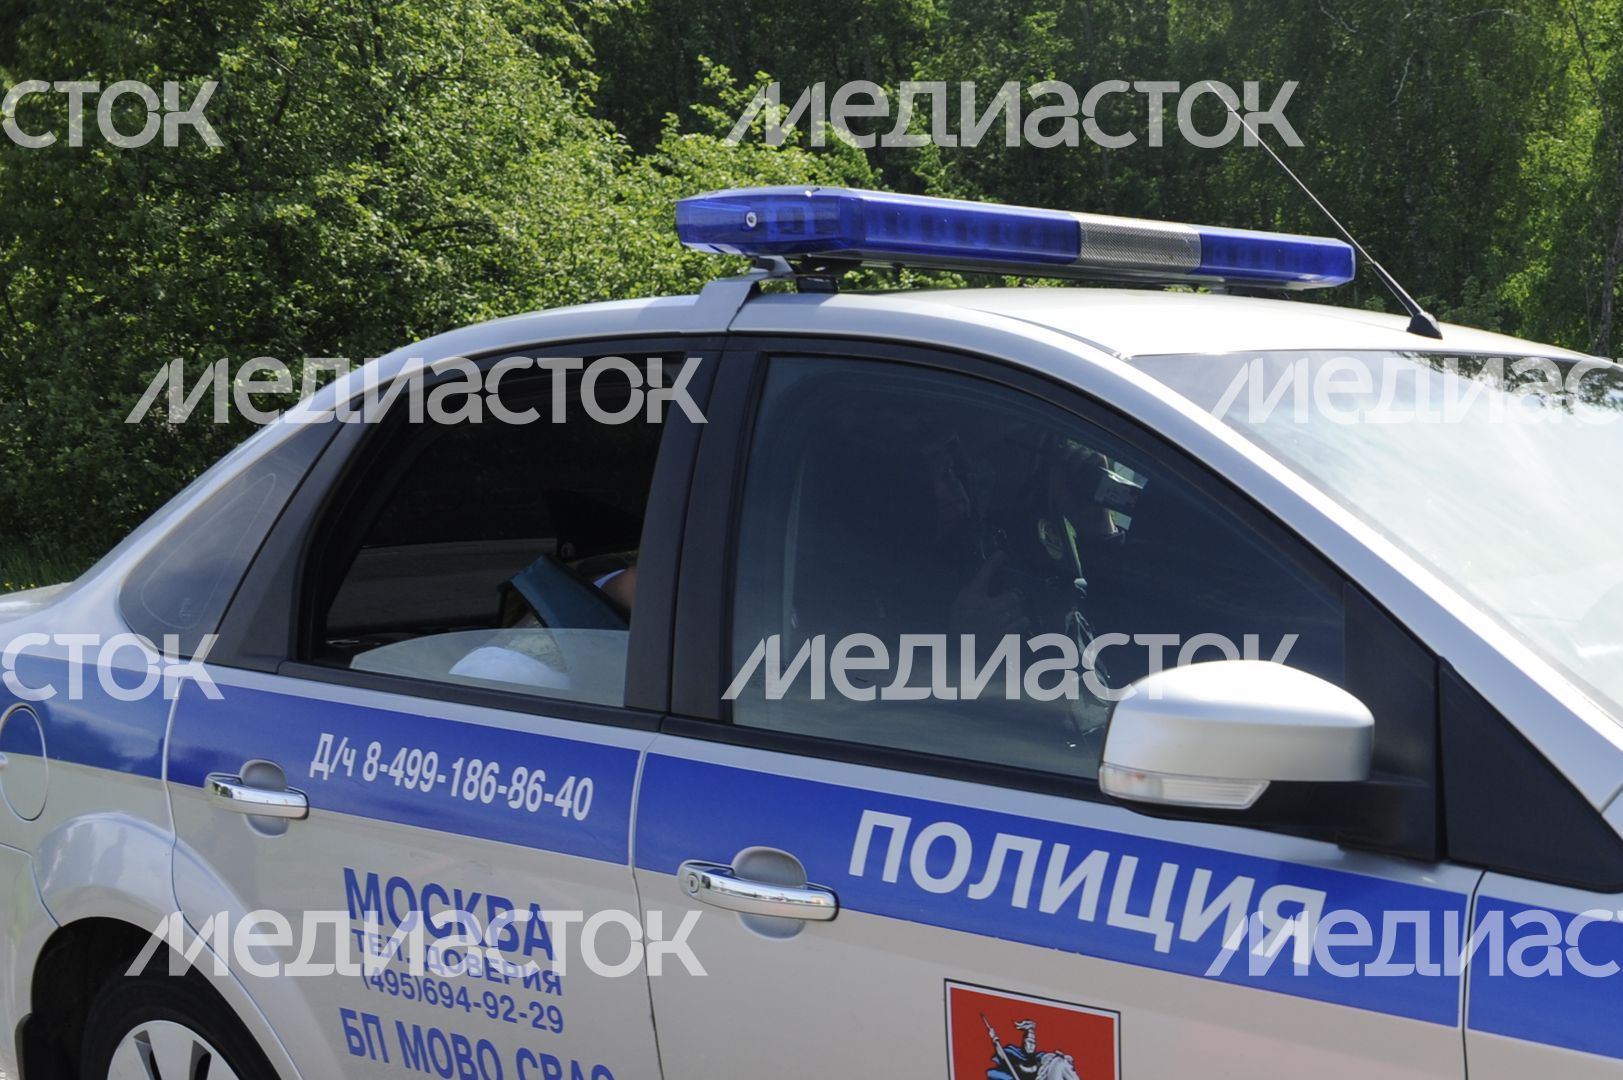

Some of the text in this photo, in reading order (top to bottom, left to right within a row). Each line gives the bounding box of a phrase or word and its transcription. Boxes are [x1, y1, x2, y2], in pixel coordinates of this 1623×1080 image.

[309, 733, 594, 821] Д/ч 8-499-186-86-40
[343, 867, 558, 962] МОСКВА
[848, 809, 1327, 965] ПОЛИЦИЯ
[361, 963, 564, 1034] (495)694-92-29
[424, 944, 563, 997] ДОВЕРИЯ
[339, 1007, 391, 1064] БП
